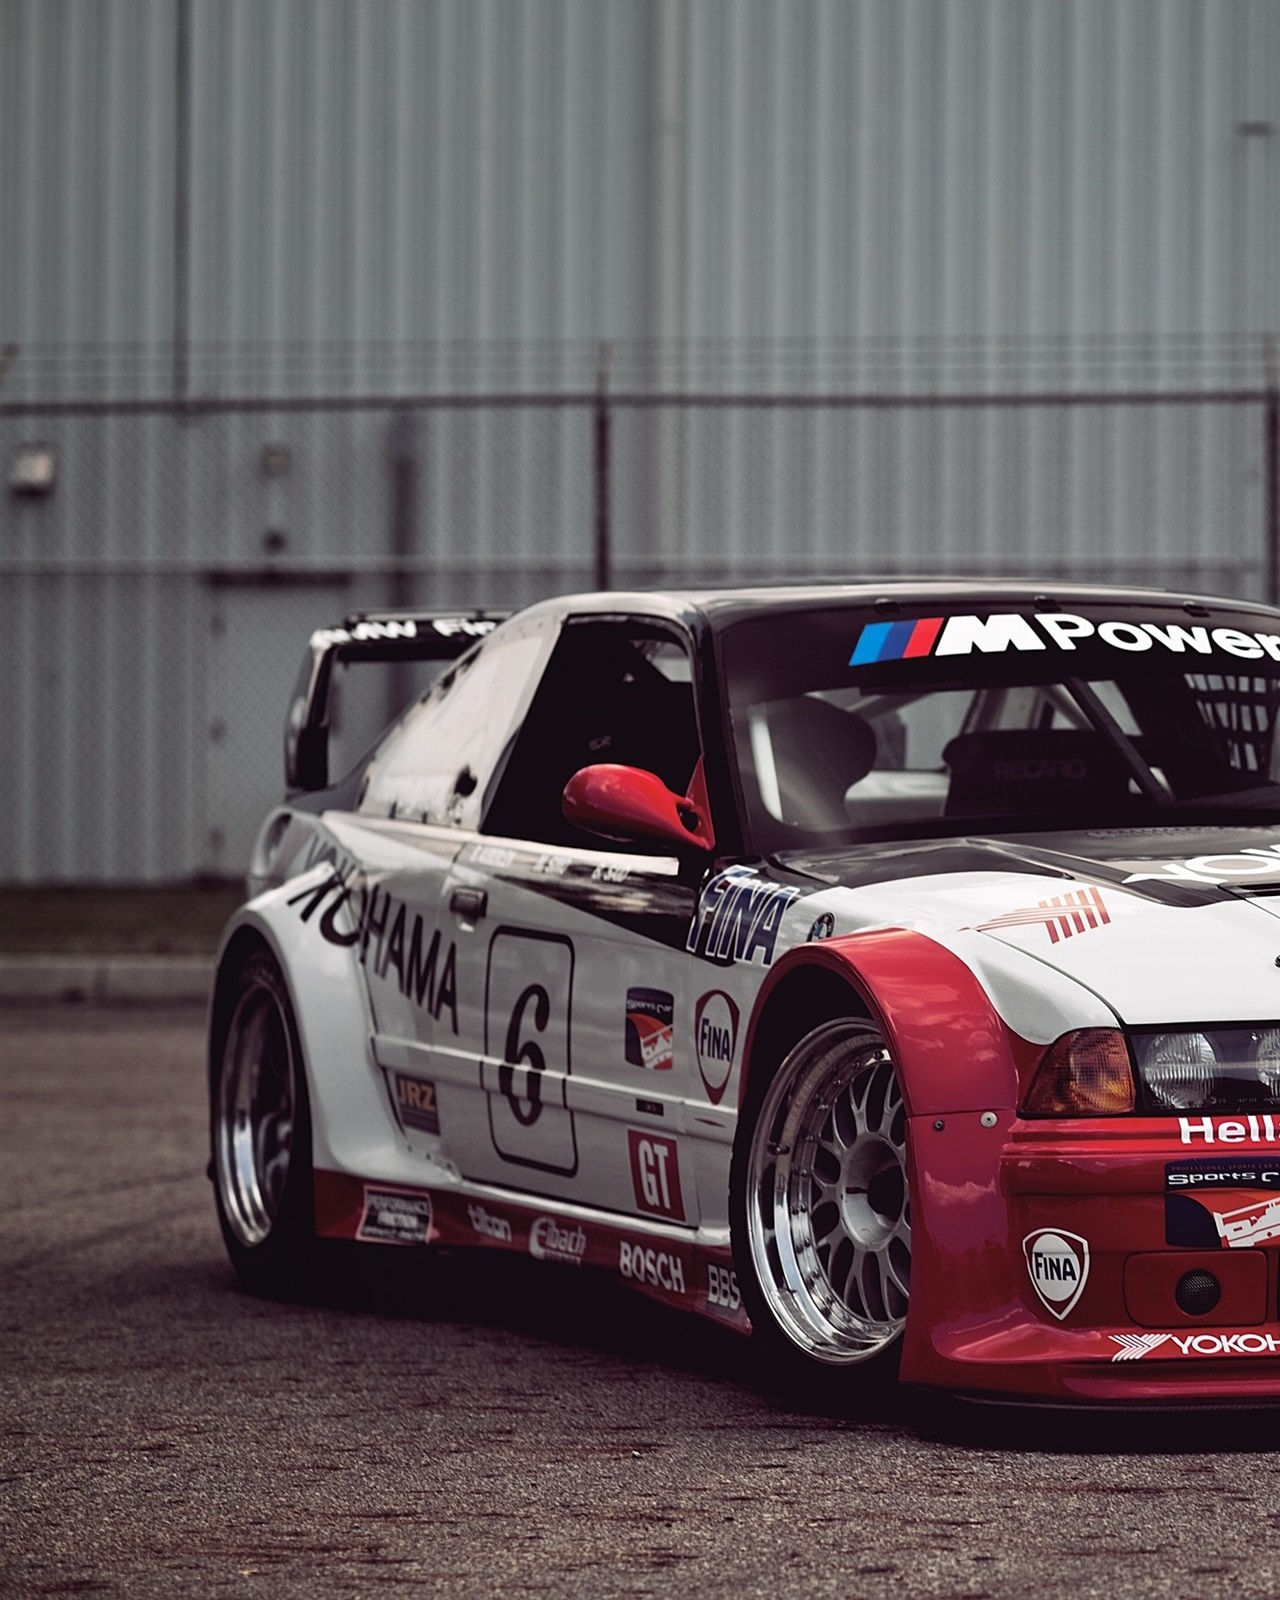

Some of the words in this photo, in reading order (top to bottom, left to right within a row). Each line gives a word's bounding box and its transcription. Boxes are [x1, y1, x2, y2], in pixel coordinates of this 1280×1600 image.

[686, 864, 801, 967] FINA
[500, 983, 550, 1126] 6
[700, 1017, 730, 1062] FINA
[637, 1139, 671, 1210] GT
[1167, 1172, 1257, 1185] Sports
[619, 1241, 686, 1294] BOSCH
[708, 1264, 741, 1310] BBS
[1033, 1251, 1077, 1282] FINA
